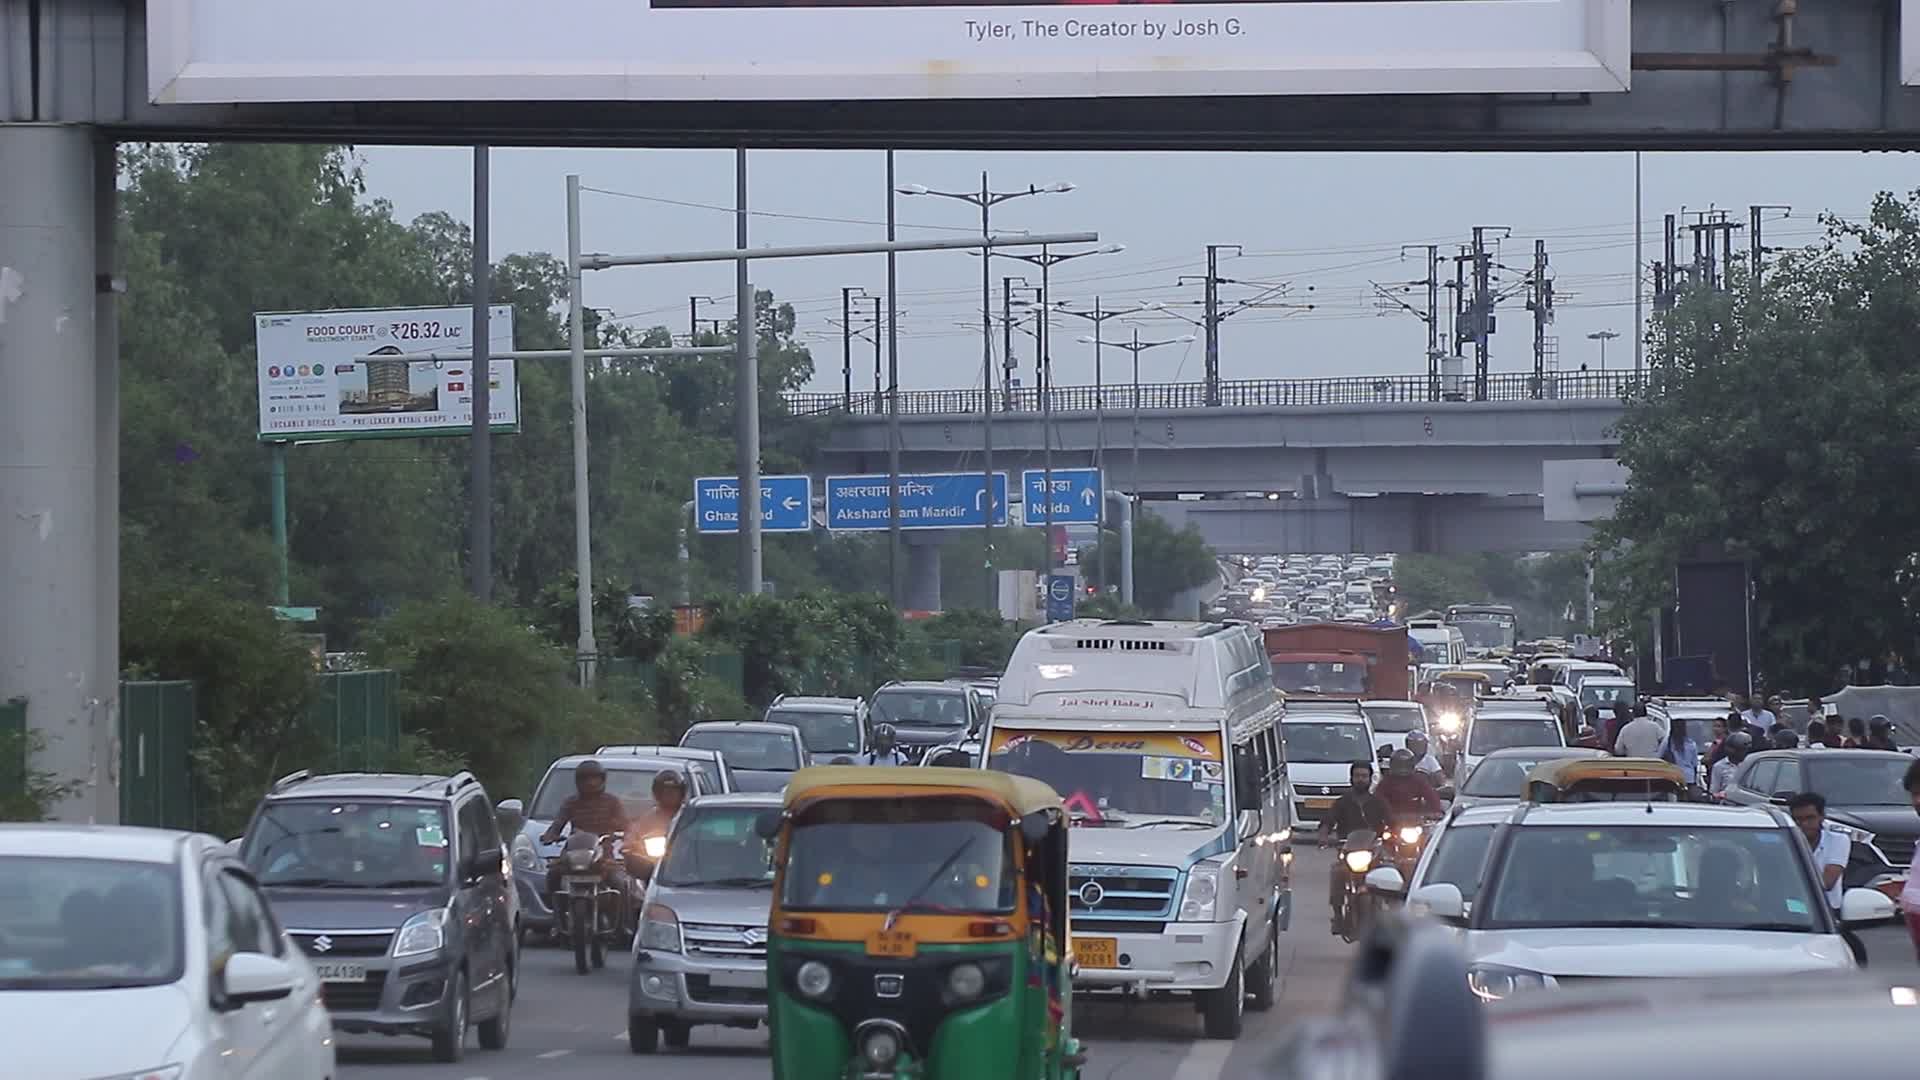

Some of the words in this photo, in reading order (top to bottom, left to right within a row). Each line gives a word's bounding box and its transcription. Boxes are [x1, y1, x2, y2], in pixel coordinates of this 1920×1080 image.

[964, 20, 1016, 41] Tyler,
[1021, 20, 1059, 37] The
[1064, 19, 1138, 37] Creator
[1143, 19, 1166, 39] by
[1172, 18, 1219, 37] Josh
[1224, 18, 1247, 36] G.
[306, 326, 336, 337] FOOD
[338, 324, 375, 336] COURT
[390, 321, 440, 341] ₹26.32
[836, 507, 918, 520] Akshardam
[922, 506, 967, 518] Mandir
[1060, 697, 1078, 707] Jai
[1082, 698, 1109, 707] Shri
